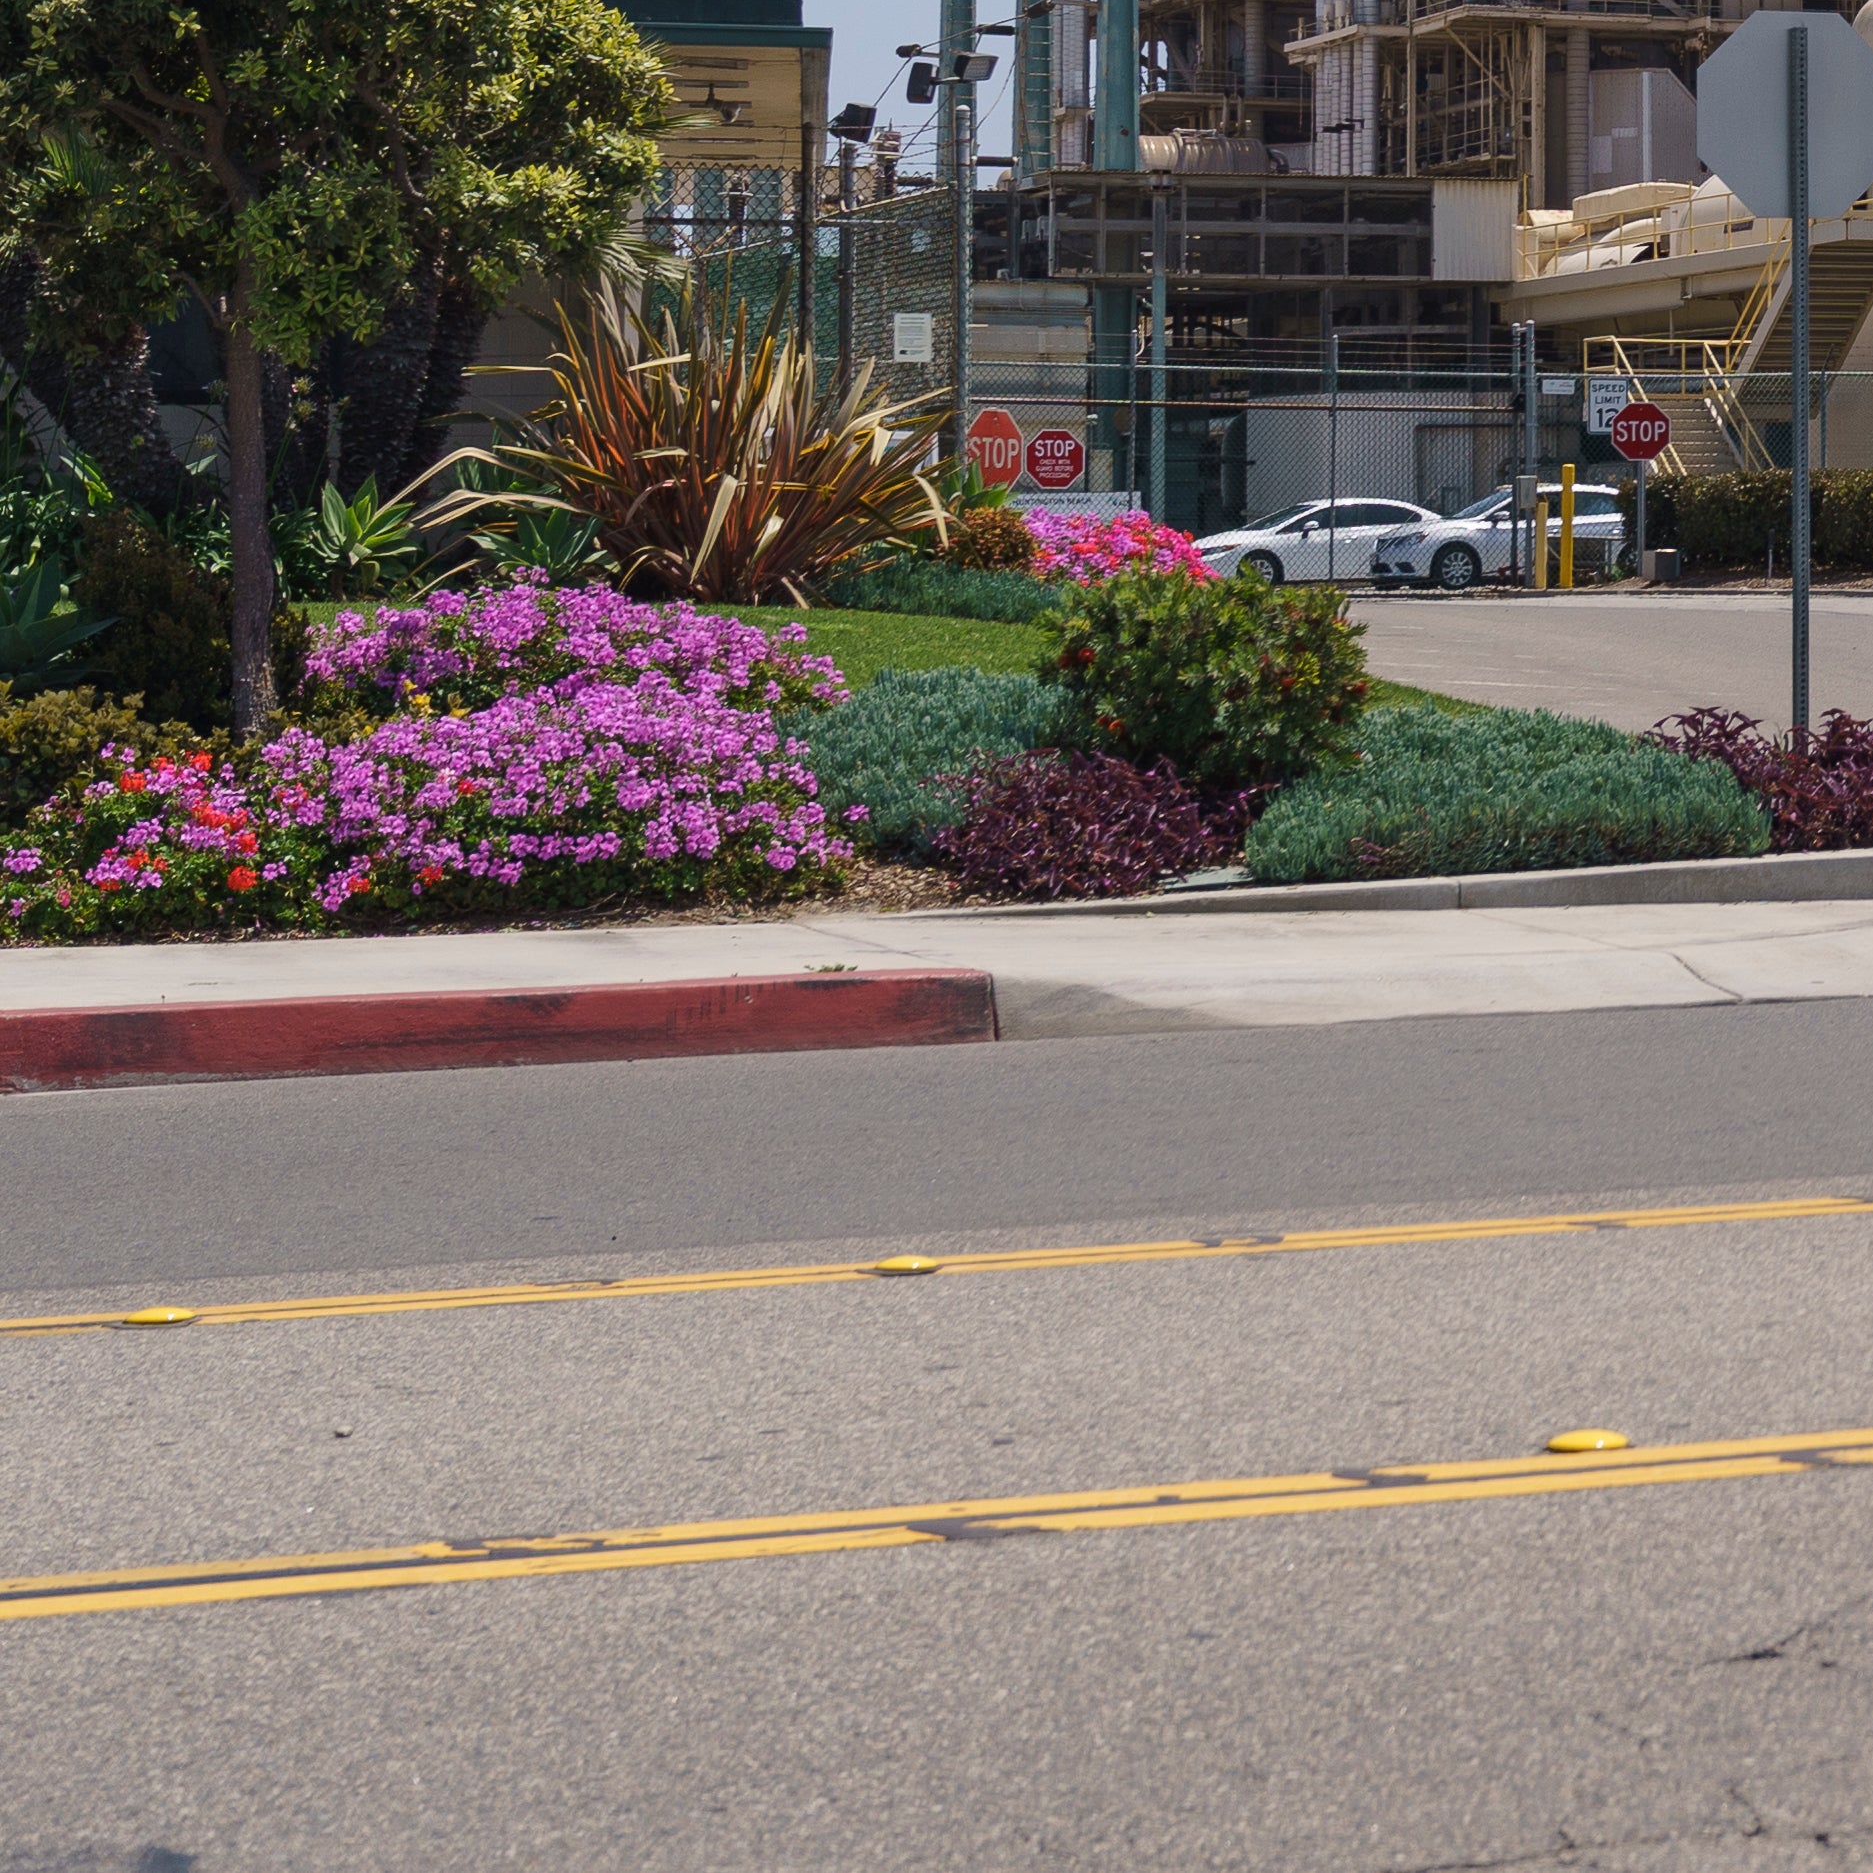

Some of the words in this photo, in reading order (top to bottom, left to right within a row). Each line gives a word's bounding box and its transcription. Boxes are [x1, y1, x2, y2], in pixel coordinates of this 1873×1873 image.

[1591, 384, 1625, 393] SPEED
[1595, 396, 1621, 405] LIMIT
[1596, 408, 1619, 428] 12
[1616, 421, 1666, 442] STOP
[967, 436, 1020, 469] STOP
[1035, 439, 1075, 457] STOP
